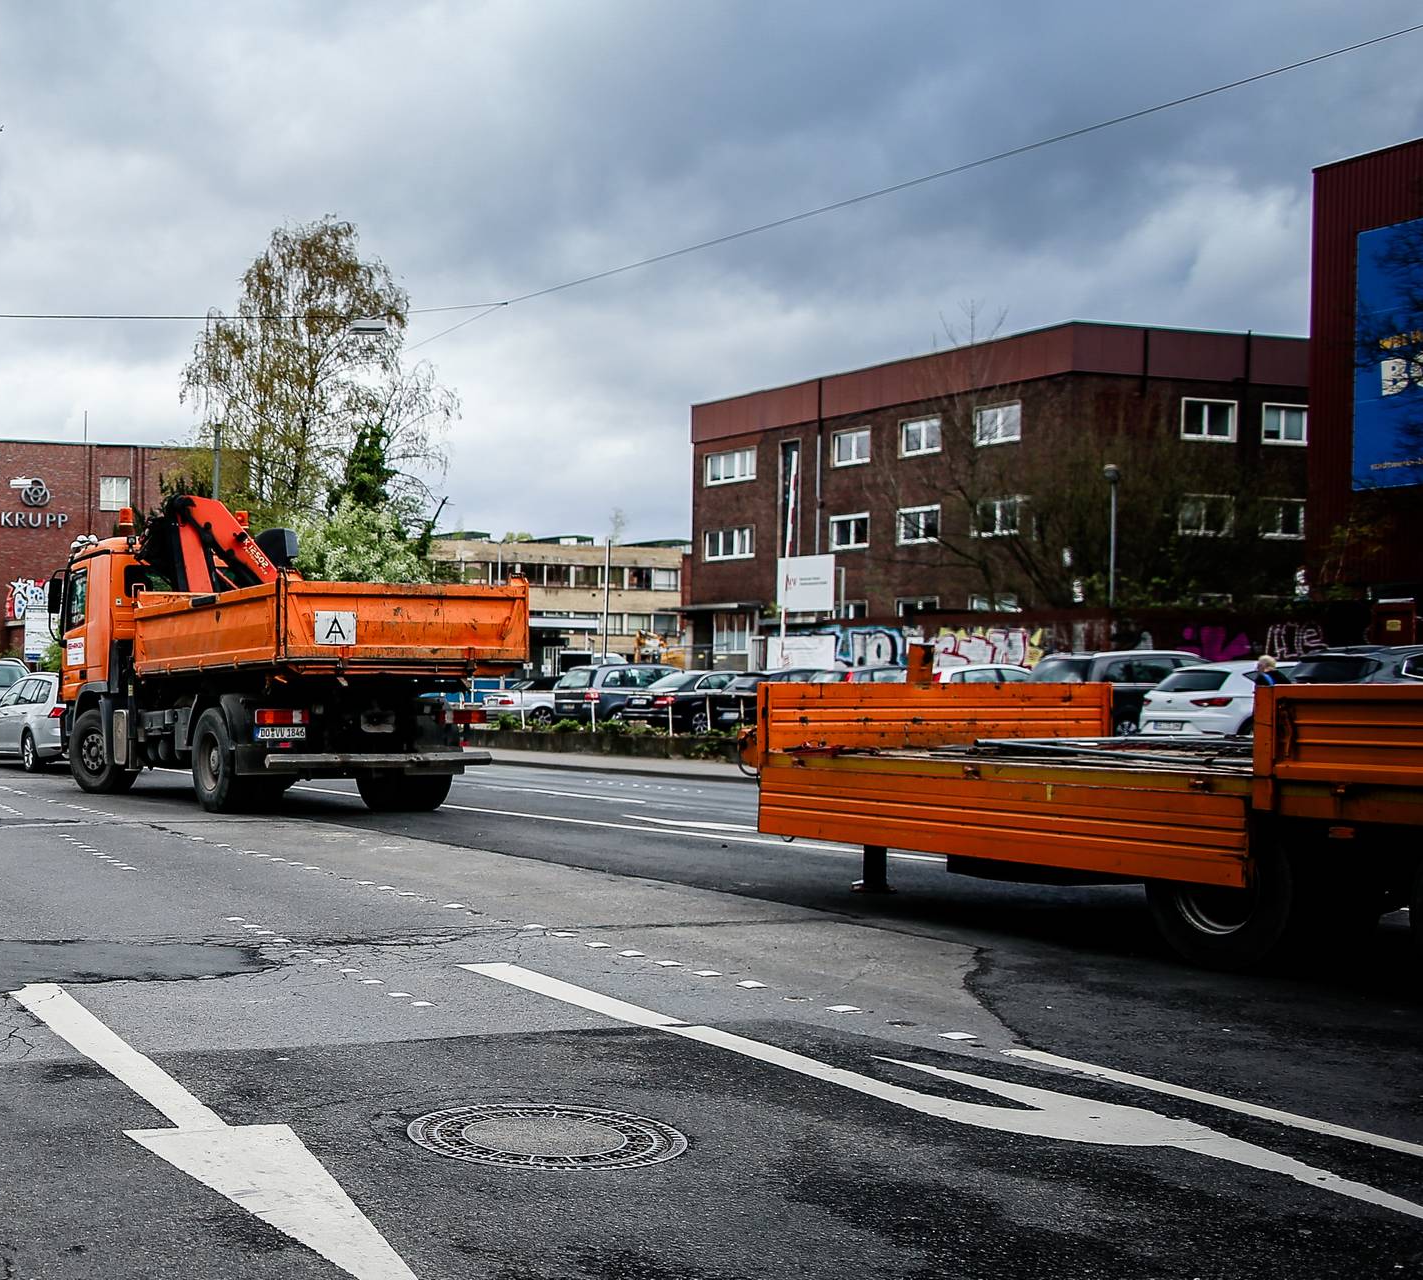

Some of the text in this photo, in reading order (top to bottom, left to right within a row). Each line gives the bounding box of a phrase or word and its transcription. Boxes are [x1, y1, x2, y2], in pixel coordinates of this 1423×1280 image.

[0, 512, 68, 528] KRUPP
[248, 544, 269, 569] 12502
[325, 616, 346, 640] A
[260, 729, 270, 737] DO
[286, 728, 305, 737] 1846
